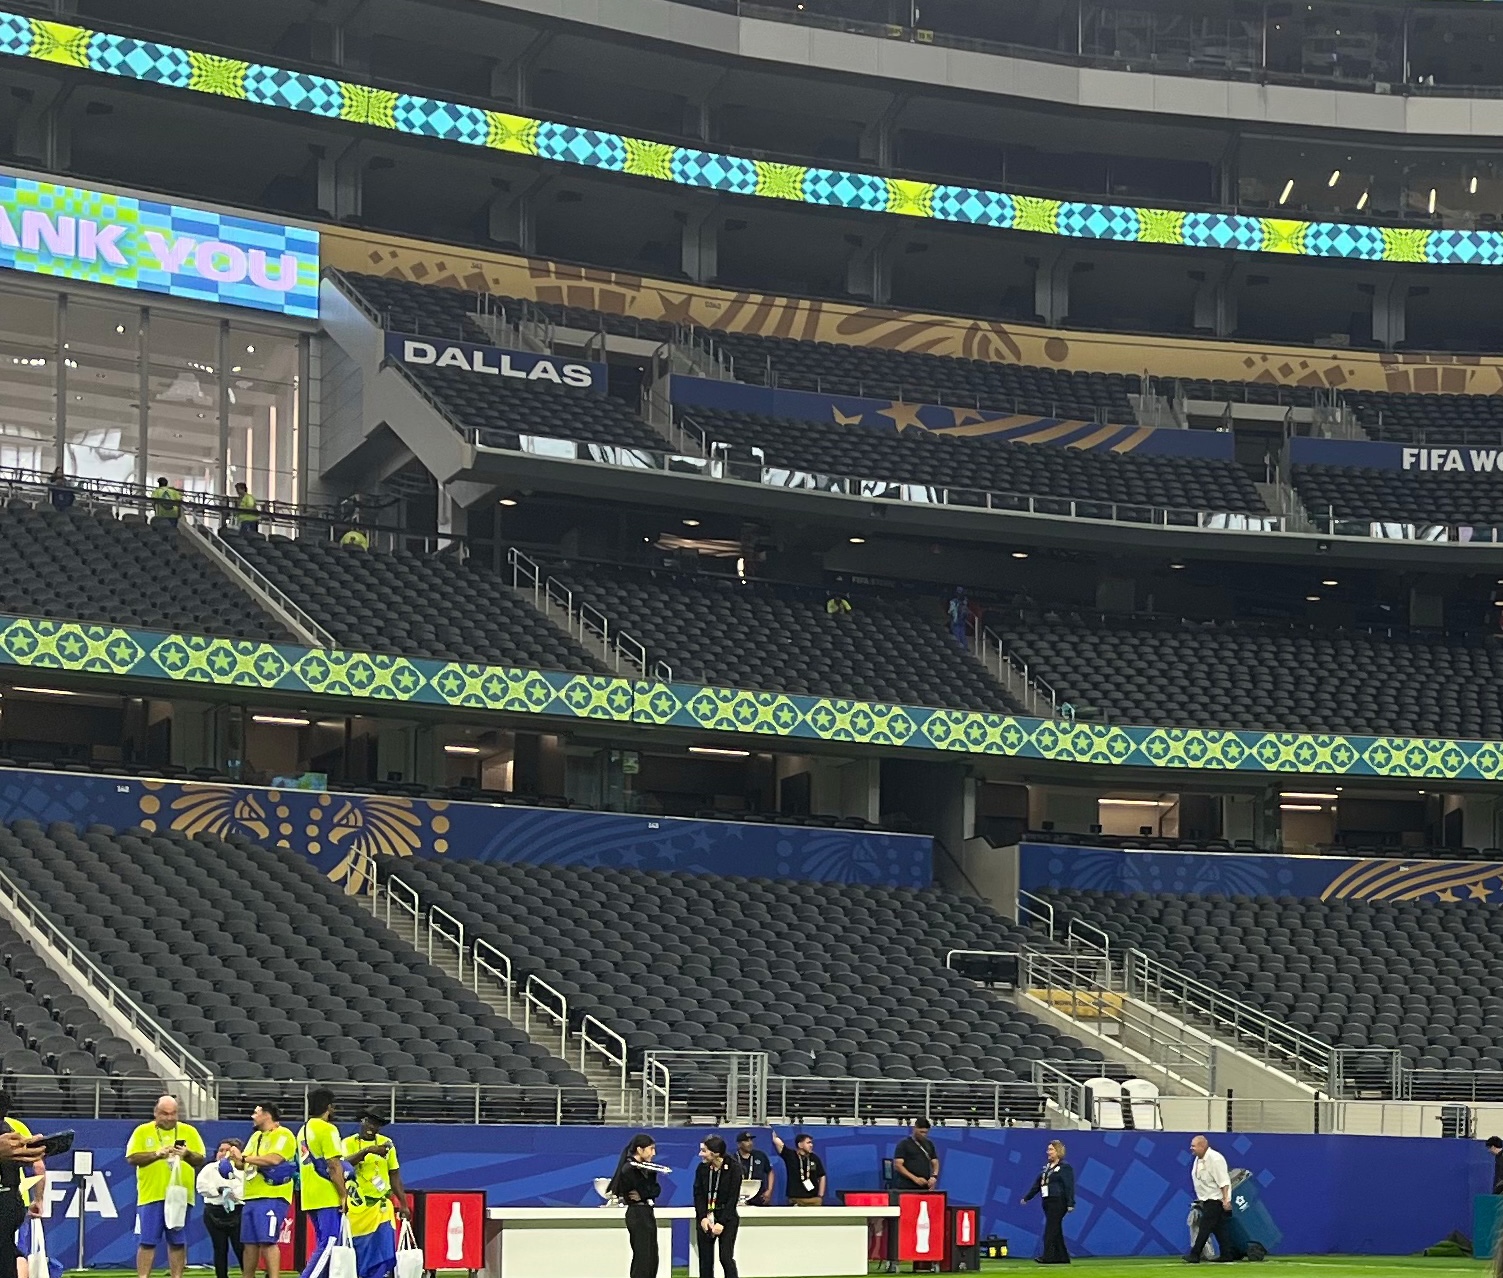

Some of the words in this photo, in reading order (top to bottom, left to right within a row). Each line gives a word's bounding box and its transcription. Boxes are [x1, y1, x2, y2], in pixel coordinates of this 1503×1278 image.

[144, 230, 298, 291] YOU
[404, 340, 592, 388] DALLAS
[1402, 447, 1465, 472] FIFA
[41, 1170, 118, 1218] FA
